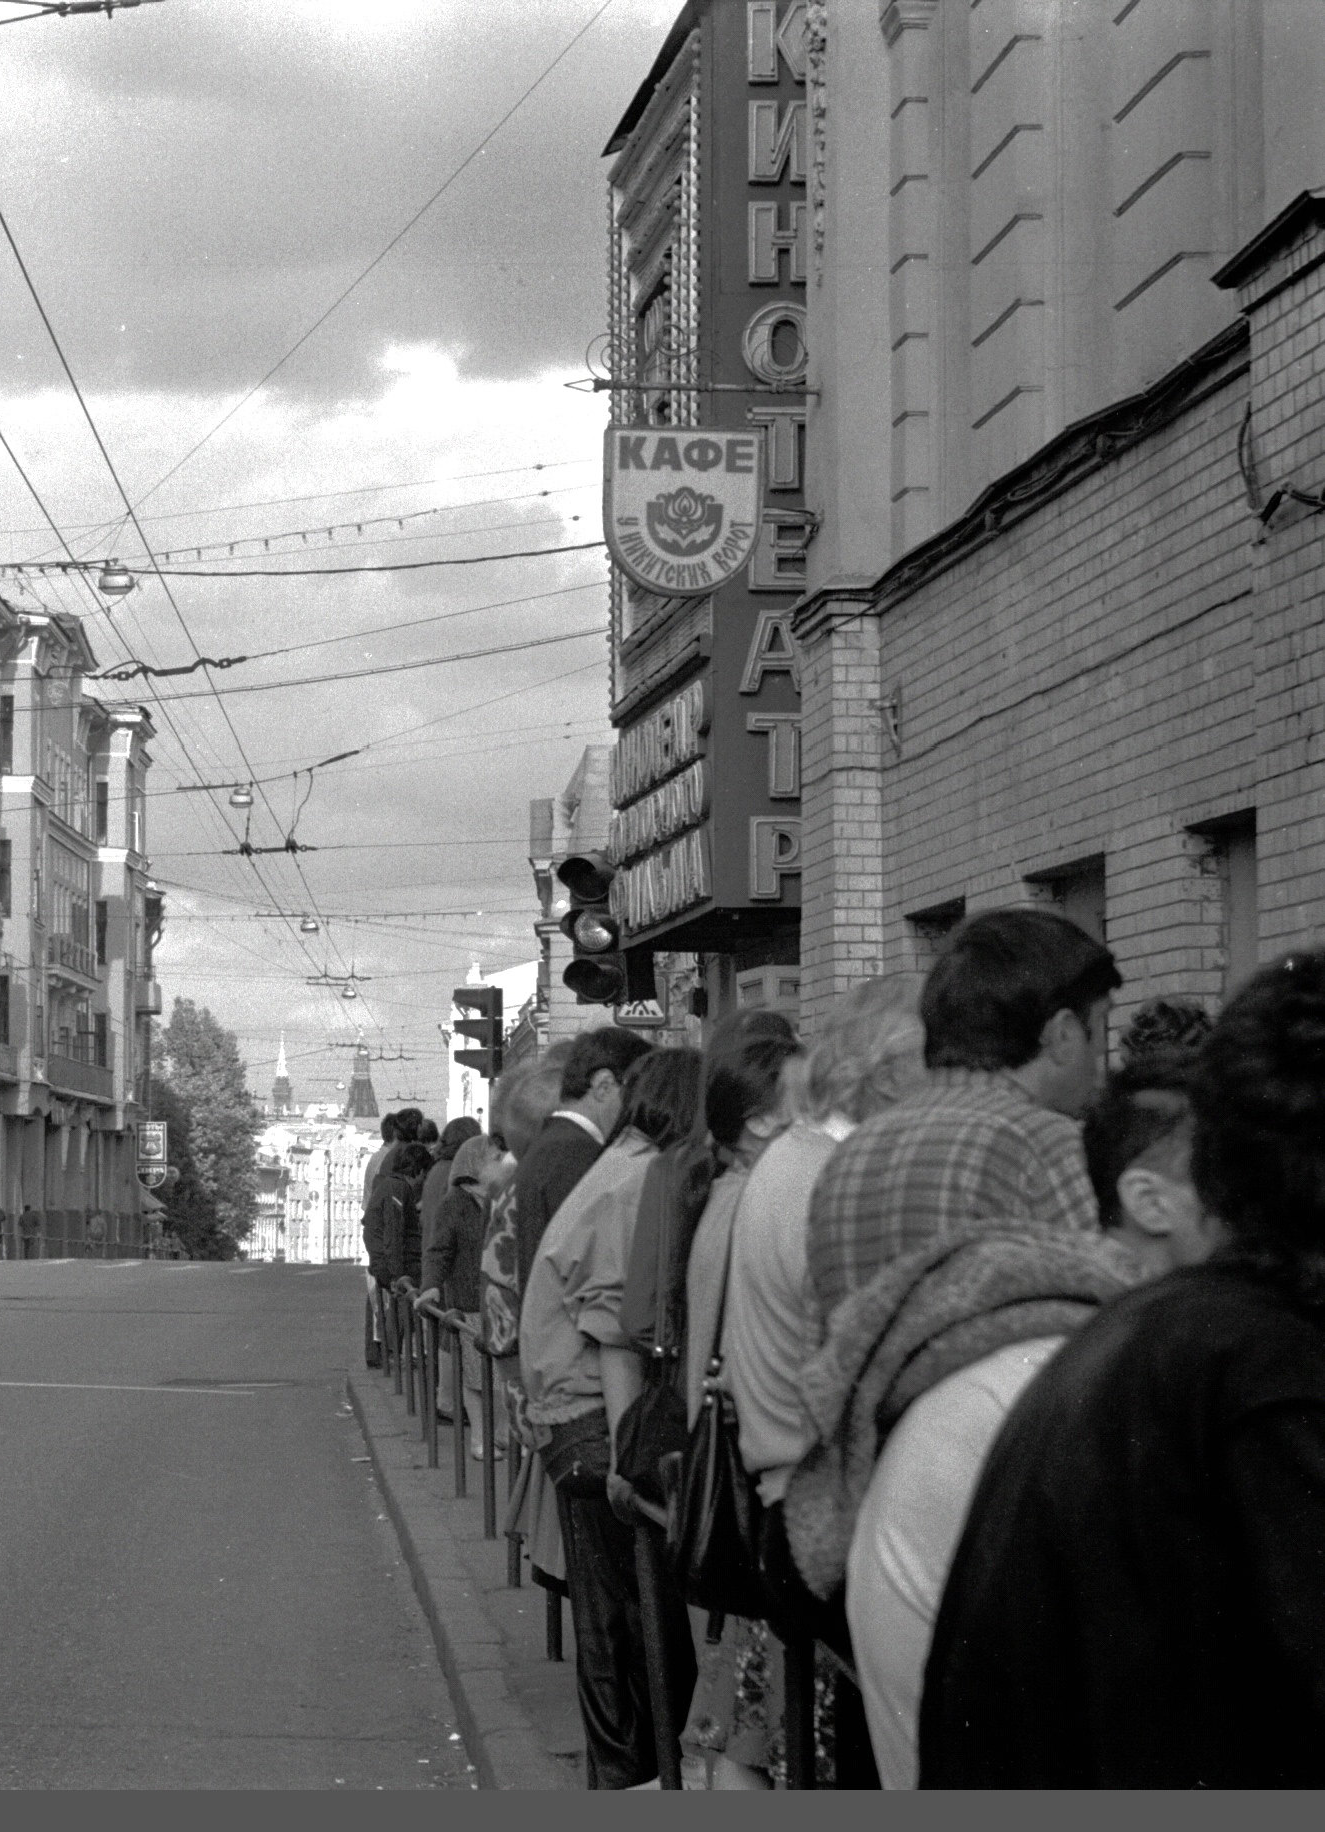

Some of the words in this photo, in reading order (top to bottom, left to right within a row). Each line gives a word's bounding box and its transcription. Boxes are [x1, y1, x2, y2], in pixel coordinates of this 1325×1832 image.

[618, 436, 754, 474] КАФЕ
[616, 517, 640, 526] У
[618, 531, 713, 588] НИКИТСКИХ
[711, 520, 754, 572] ВОРОТ
